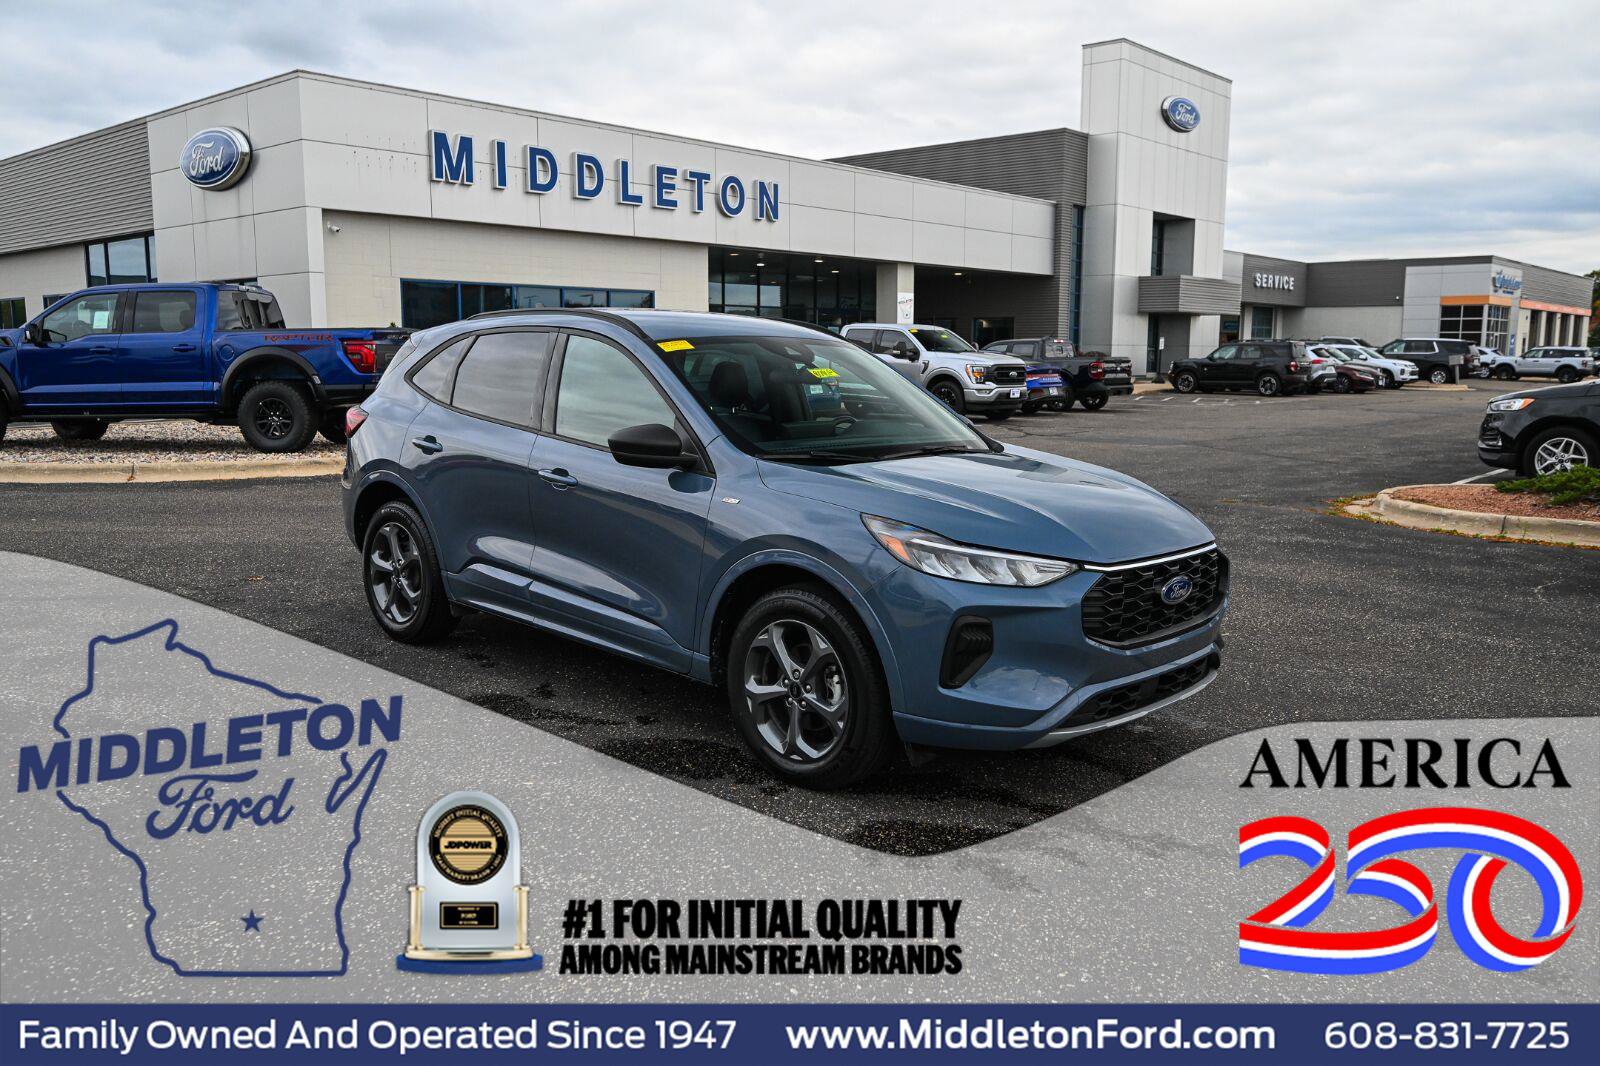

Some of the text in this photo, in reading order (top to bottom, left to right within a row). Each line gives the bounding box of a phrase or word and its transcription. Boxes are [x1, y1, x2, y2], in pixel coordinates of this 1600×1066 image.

[1175, 102, 1196, 124] Ford
[189, 141, 225, 176] Ford
[430, 129, 779, 222] MIDDLETON
[1255, 273, 1295, 290] SERVICE
